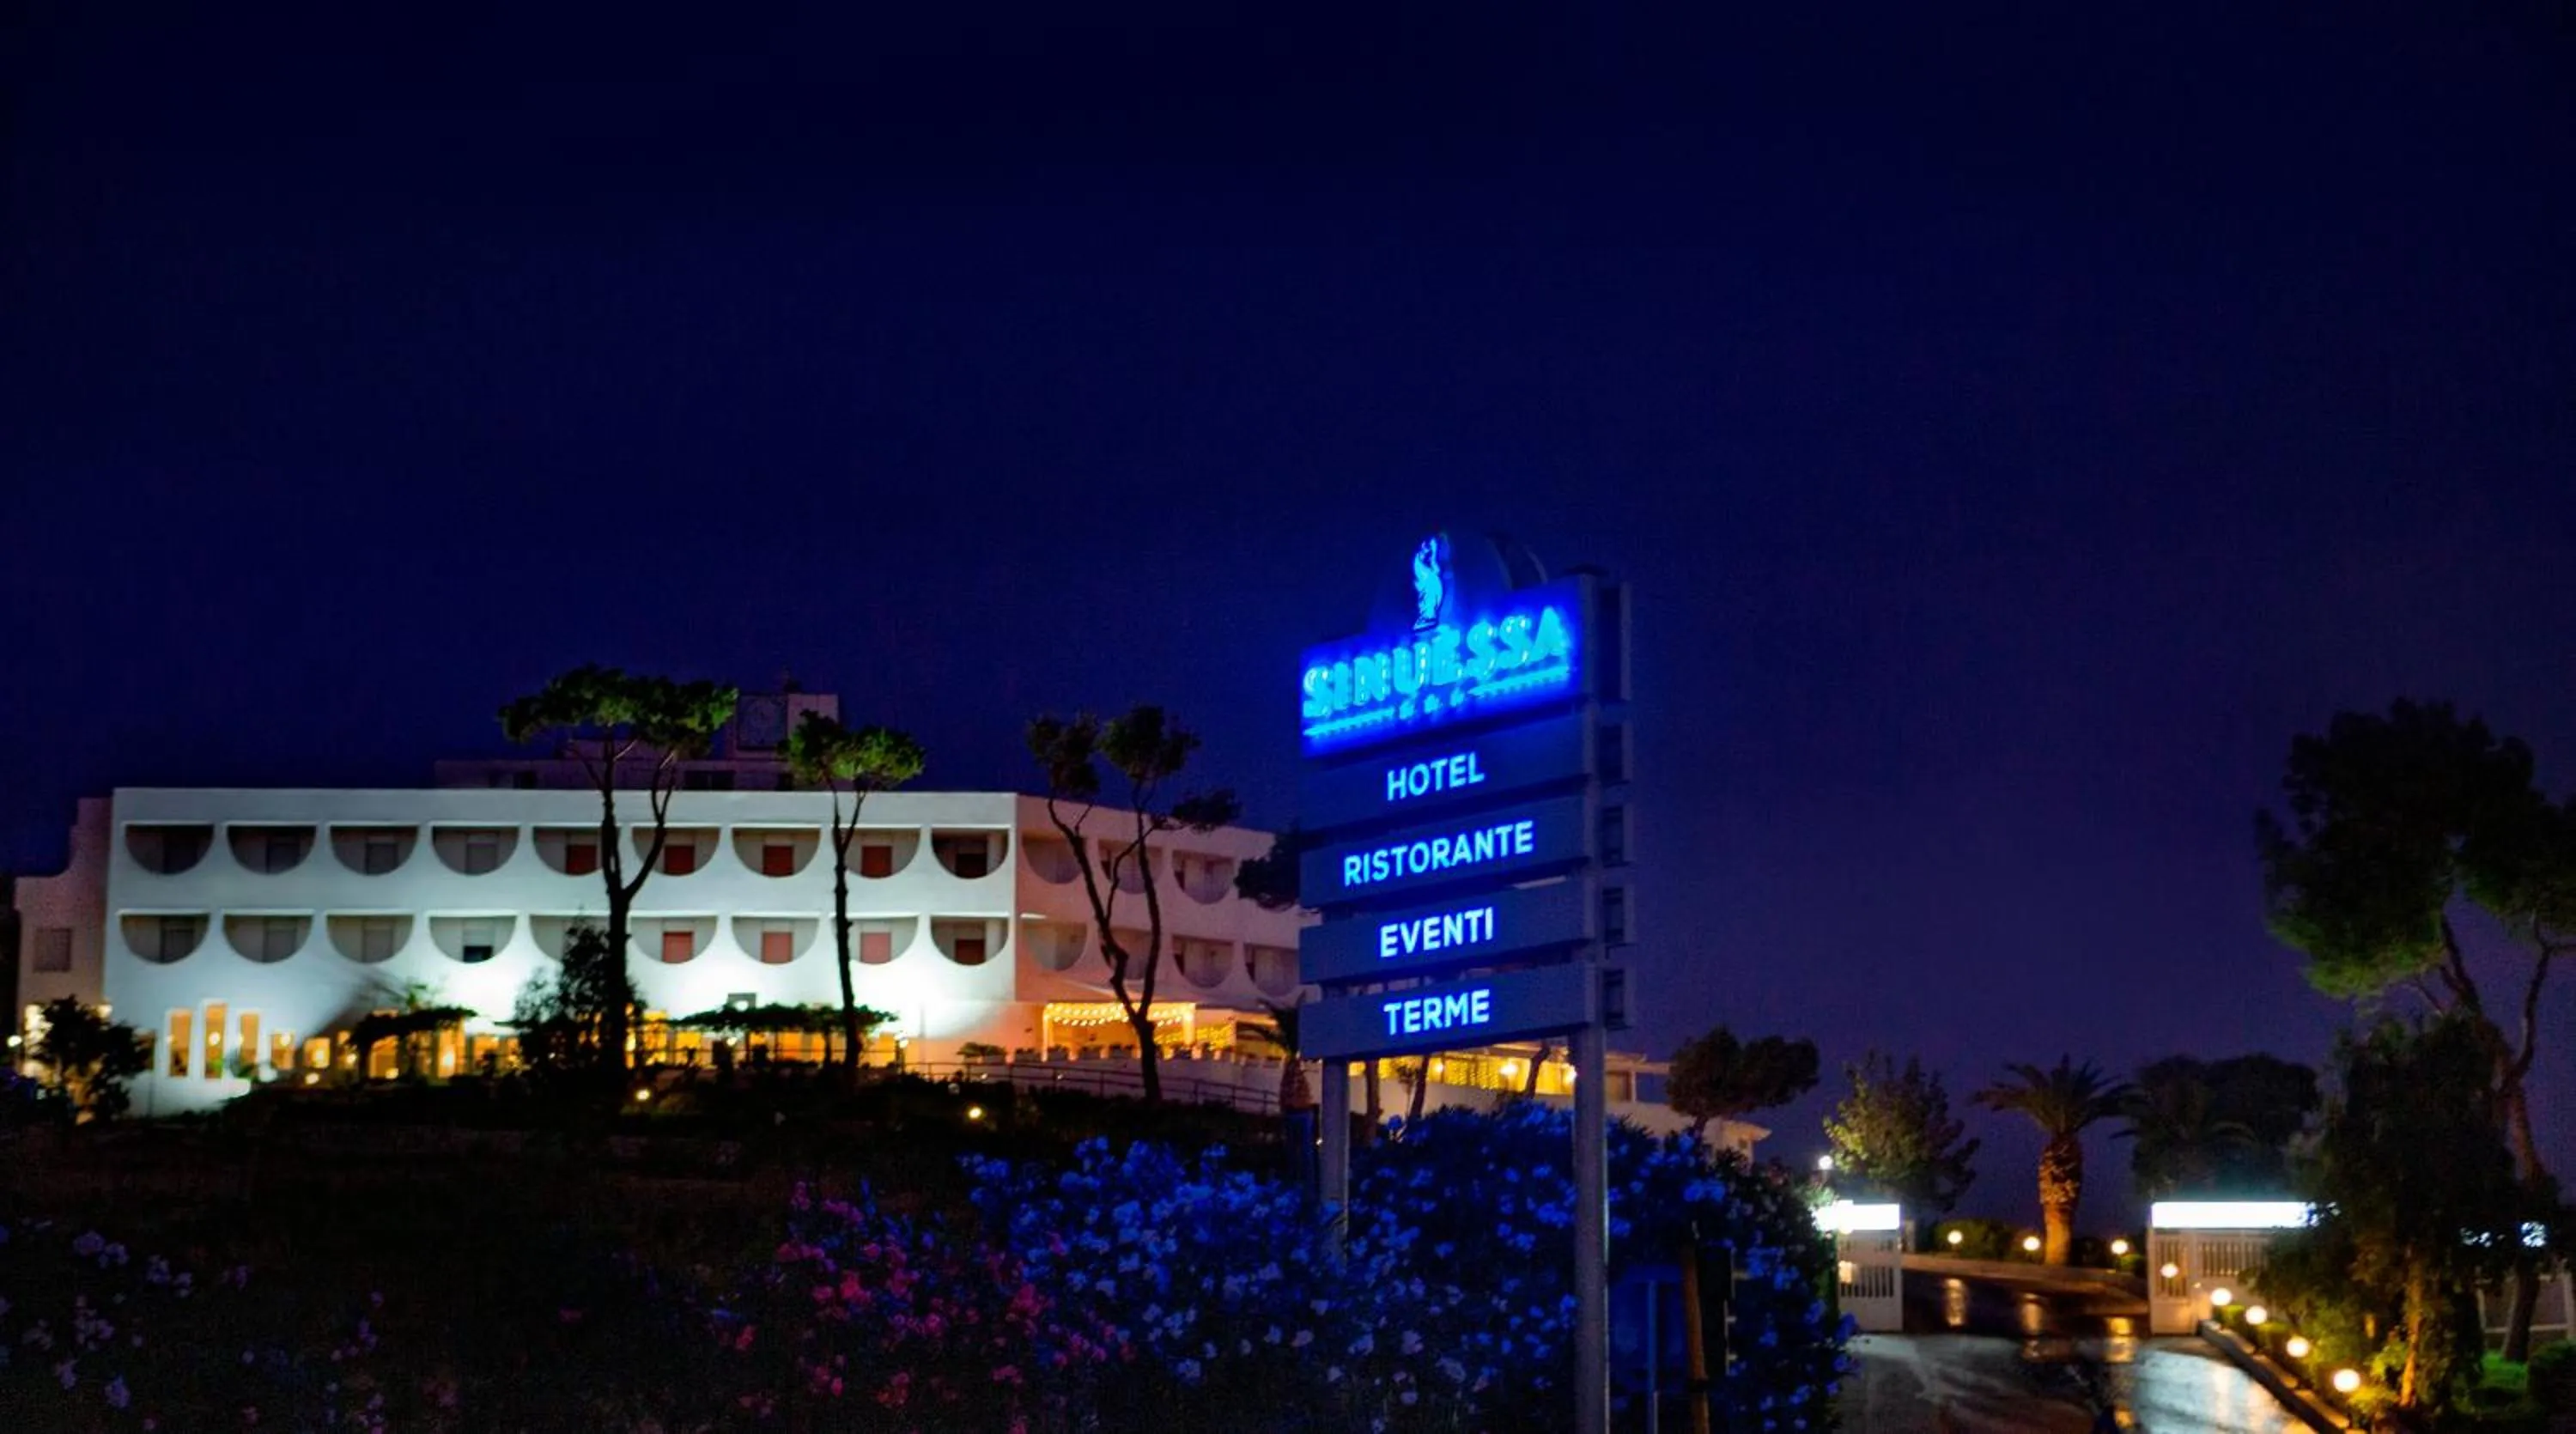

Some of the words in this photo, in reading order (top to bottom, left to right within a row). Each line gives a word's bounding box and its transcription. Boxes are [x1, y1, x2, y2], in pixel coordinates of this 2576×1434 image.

[1303, 606, 1569, 718] SINUESSA
[1387, 752, 1484, 800] HOTEL
[1344, 820, 1534, 885] RISTORANTE
[1380, 907, 1493, 957] EVENTI
[1383, 989, 1490, 1035] TERME
